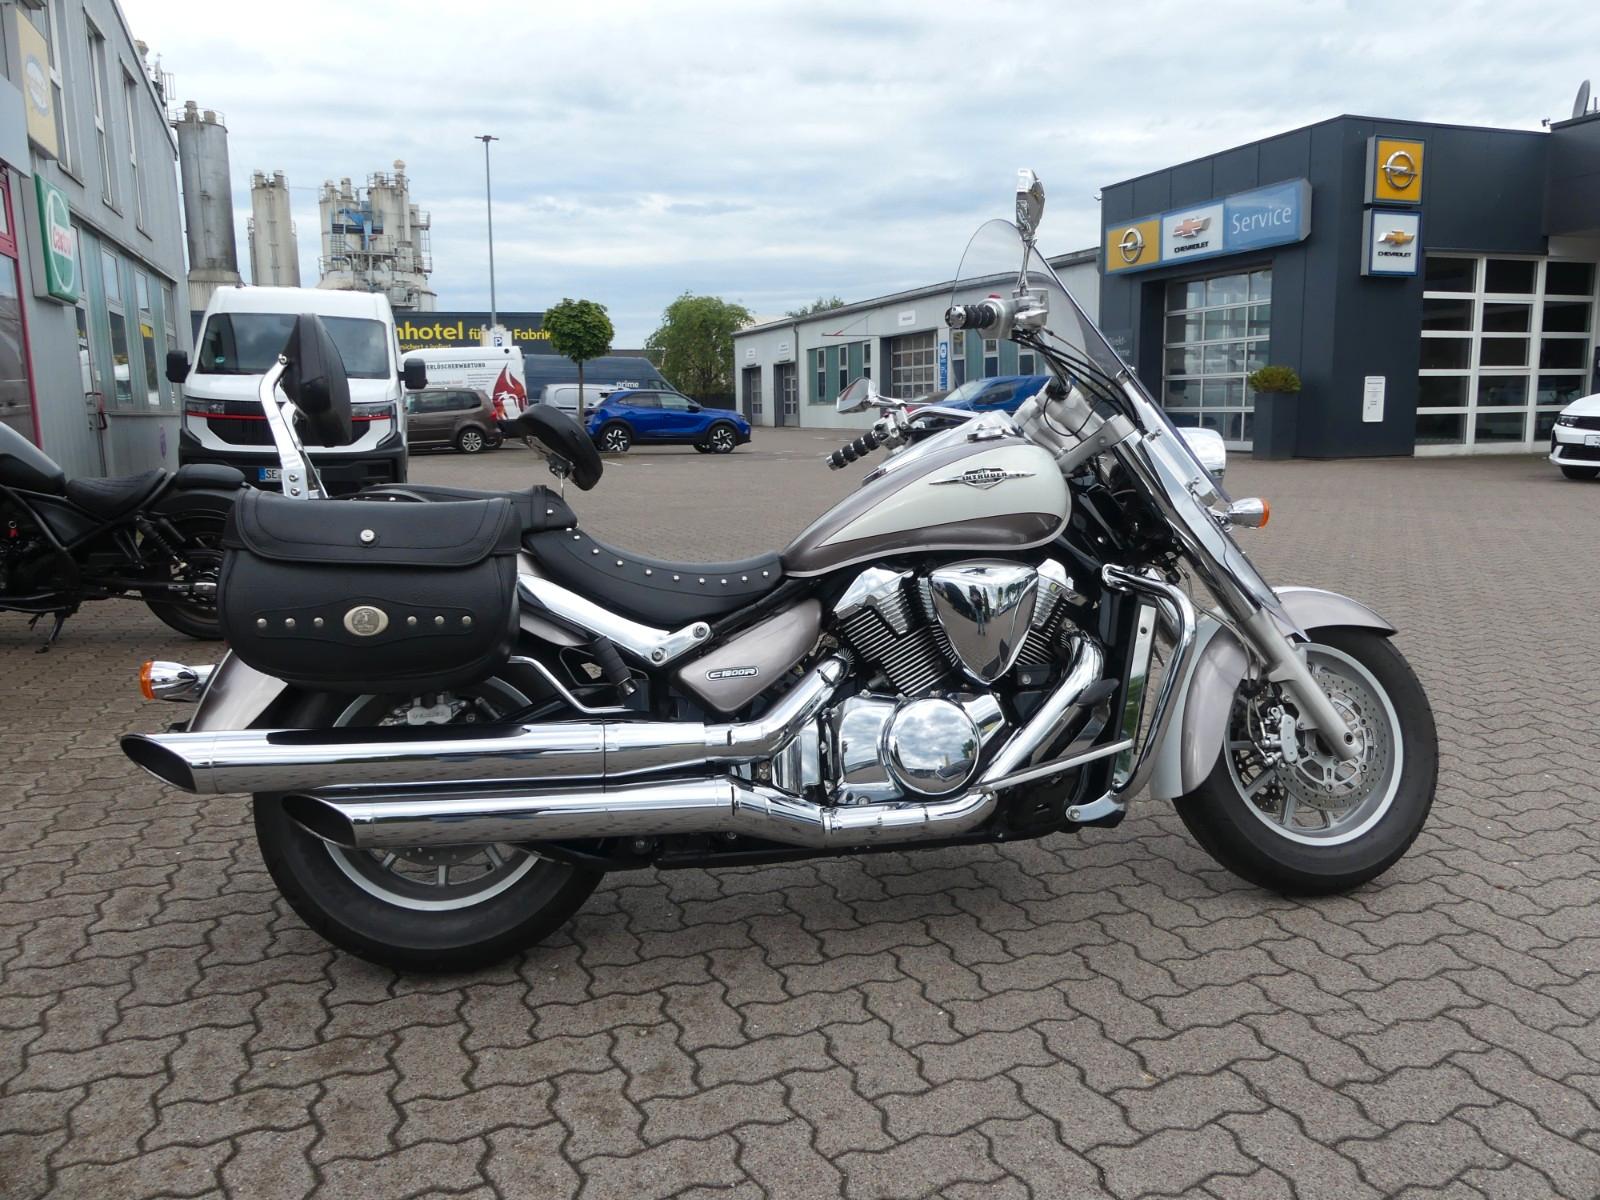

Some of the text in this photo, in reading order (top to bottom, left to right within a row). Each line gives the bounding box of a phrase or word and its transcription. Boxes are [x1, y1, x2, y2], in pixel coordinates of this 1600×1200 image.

[1232, 205, 1292, 235] Service
[1174, 241, 1209, 254] CHEVROLET
[513, 328, 551, 340] Fabrik
[616, 380, 640, 389] prime
[961, 472, 1008, 481] INTRUDER
